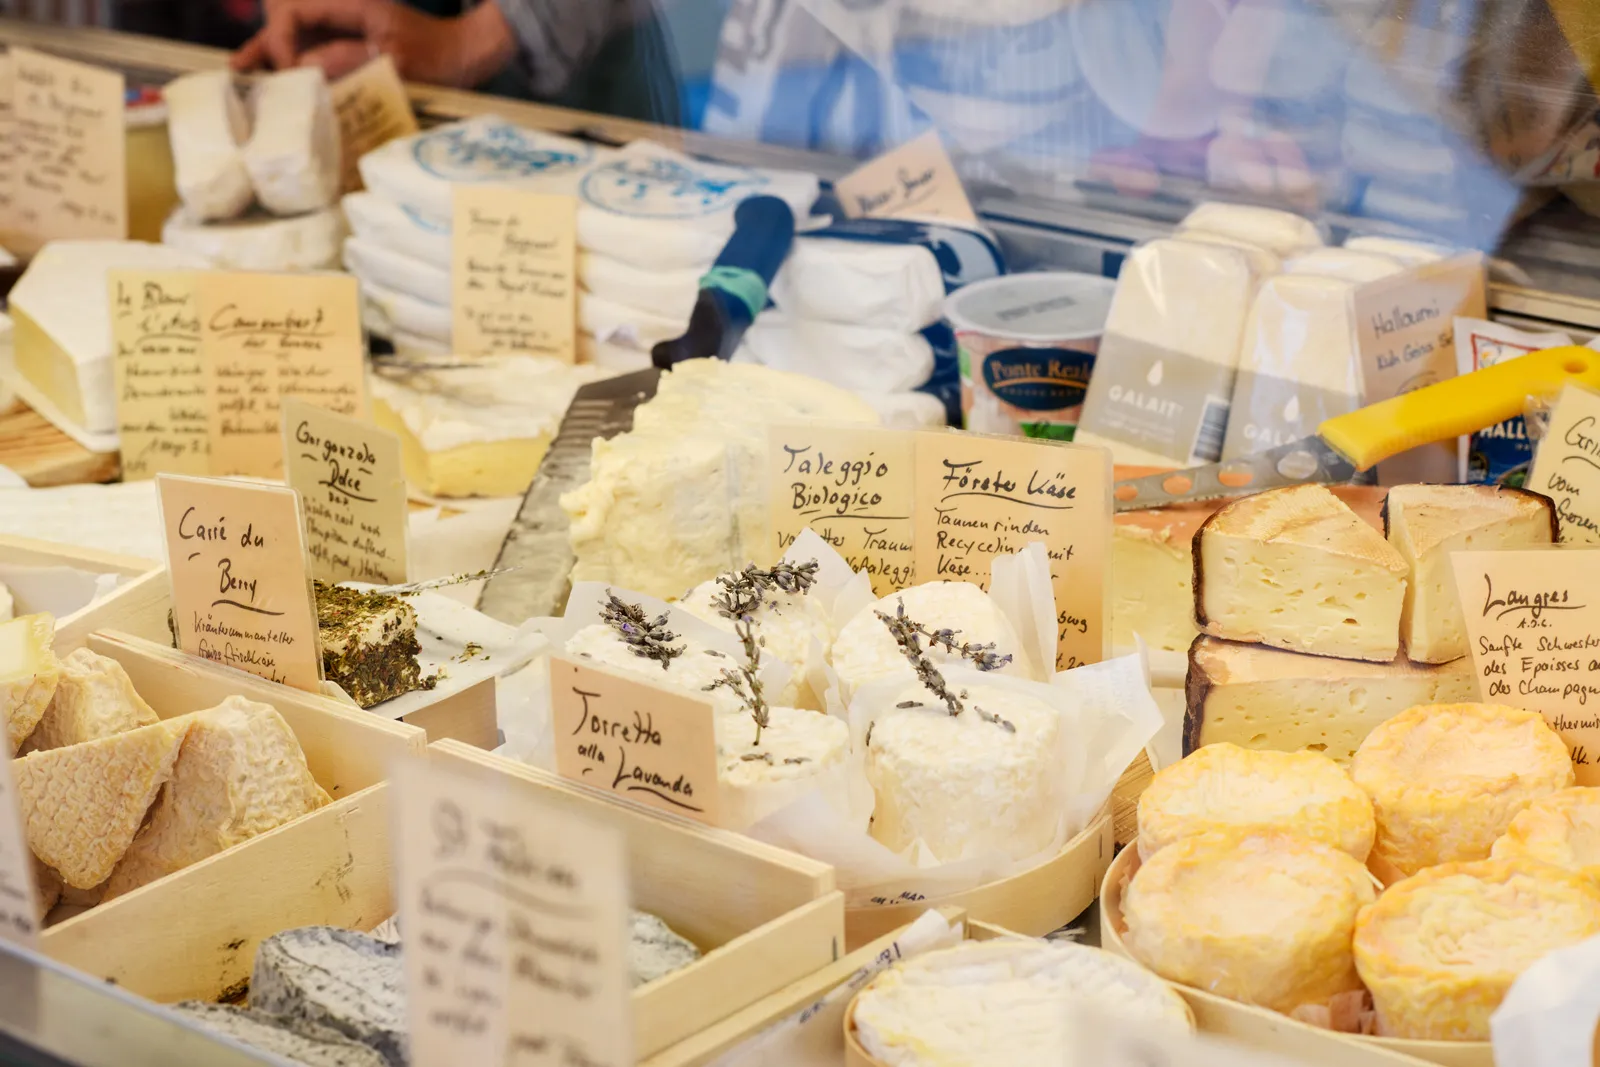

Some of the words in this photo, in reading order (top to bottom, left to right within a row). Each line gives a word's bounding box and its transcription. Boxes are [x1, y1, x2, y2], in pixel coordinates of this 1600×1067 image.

[990, 360, 1042, 380] Ponte
[1108, 384, 1178, 419] GALAIT
[296, 421, 376, 464] Gorgonzola
[1243, 423, 1298, 447] GALA
[329, 459, 361, 491] Dolce
[783, 444, 888, 486] Taleggio
[942, 458, 1016, 491] Förster
[1027, 470, 1077, 500] Käse
[790, 482, 882, 515] Biologico
[179, 506, 228, 540] Carré
[240, 523, 264, 548] du
[936, 531, 1026, 556] Recycelin
[218, 558, 257, 602] Berry
[1482, 573, 1570, 619] Langres
[1479, 634, 1523, 657] Sanfte
[1520, 656, 1580, 679] Epoisses
[571, 686, 662, 746] Torretta
[577, 743, 606, 763] alla
[612, 746, 694, 798] Lavanda
